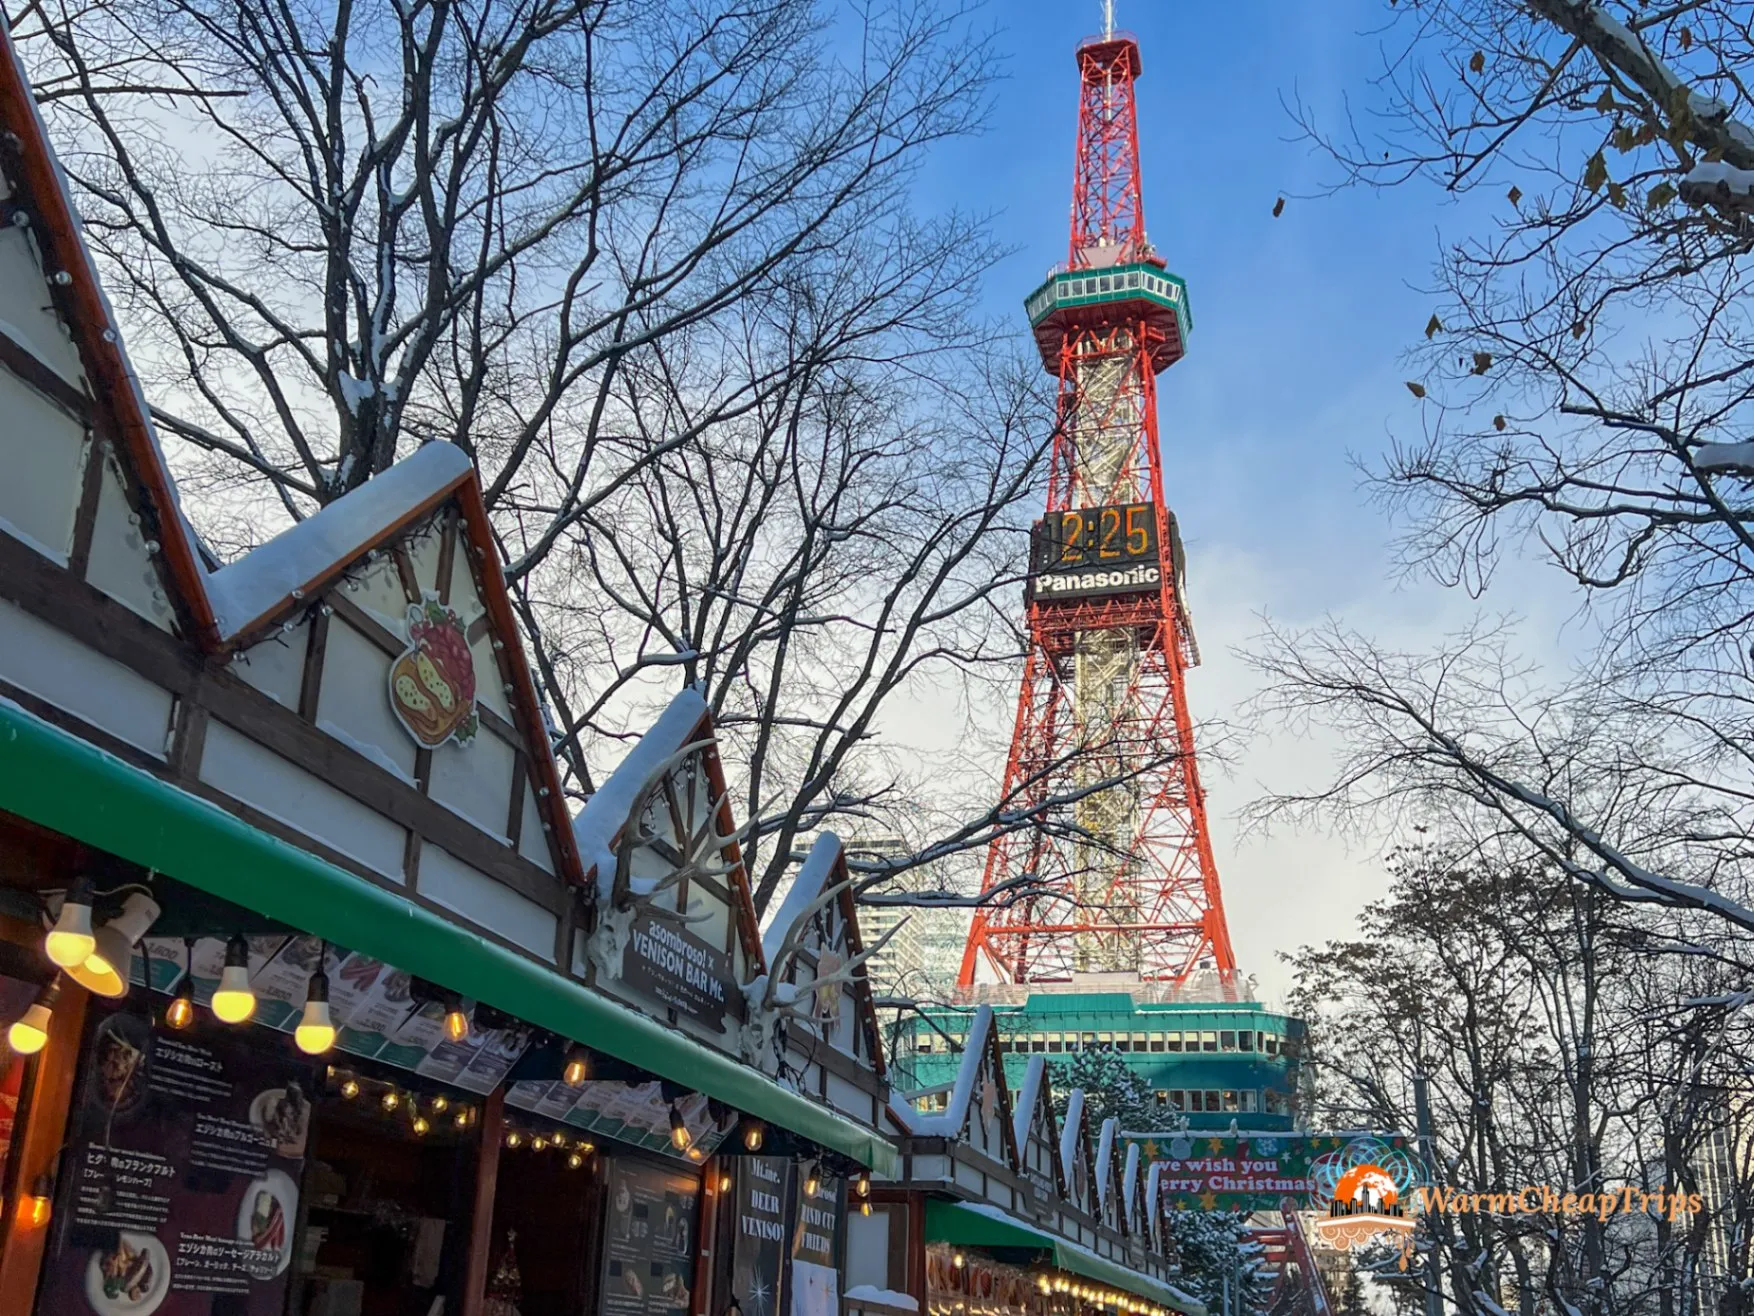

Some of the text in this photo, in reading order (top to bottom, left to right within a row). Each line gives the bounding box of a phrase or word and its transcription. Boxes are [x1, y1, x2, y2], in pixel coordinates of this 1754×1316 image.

[1035, 564, 1160, 594] Panasonic
[649, 920, 707, 969] asombroso!
[633, 929, 684, 979] VENISON
[686, 961, 708, 993] BAR
[87, 1152, 177, 1178] ヒグ肉のフランクフルト
[1196, 1158, 1235, 1173] wish
[1242, 1160, 1278, 1176] you
[1160, 1176, 1316, 1194] erry Christmas
[751, 1188, 780, 1214] DEER
